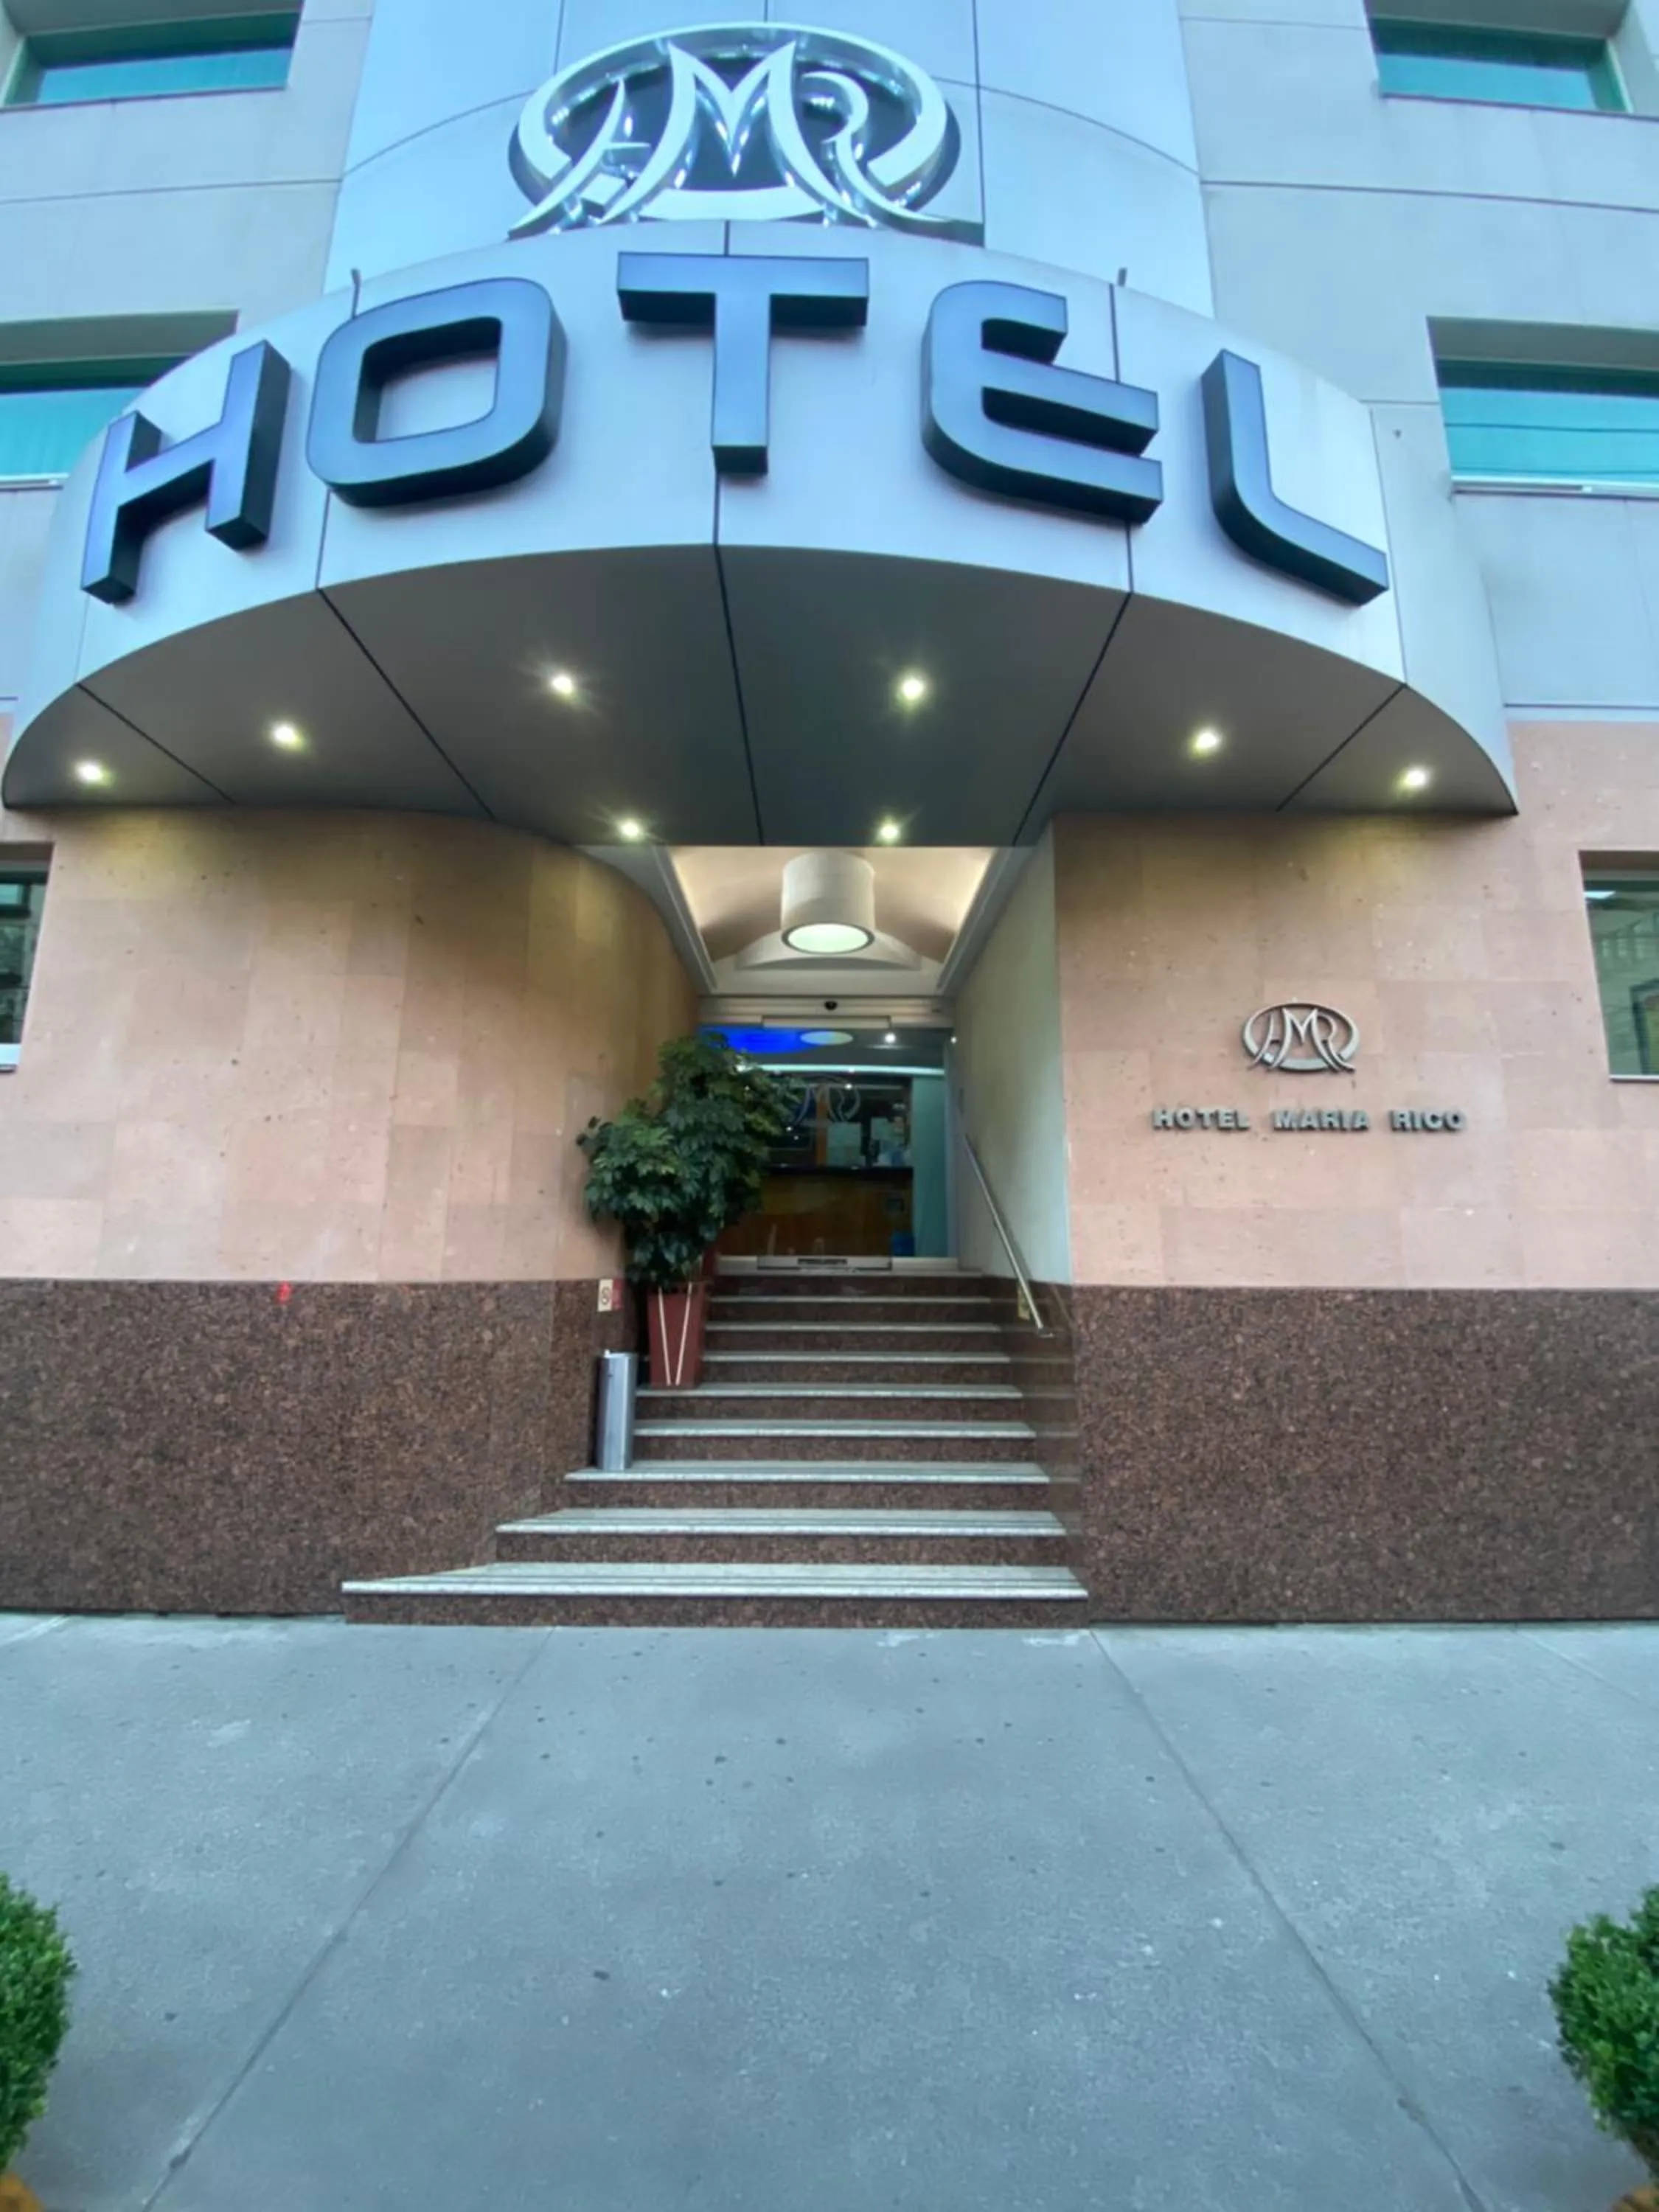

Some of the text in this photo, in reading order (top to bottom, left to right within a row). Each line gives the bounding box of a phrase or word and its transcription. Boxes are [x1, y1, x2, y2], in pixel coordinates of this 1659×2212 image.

[80, 252, 1390, 605] HOTEL
[1153, 1107, 1465, 1132] HOTEL MARIA RICO
